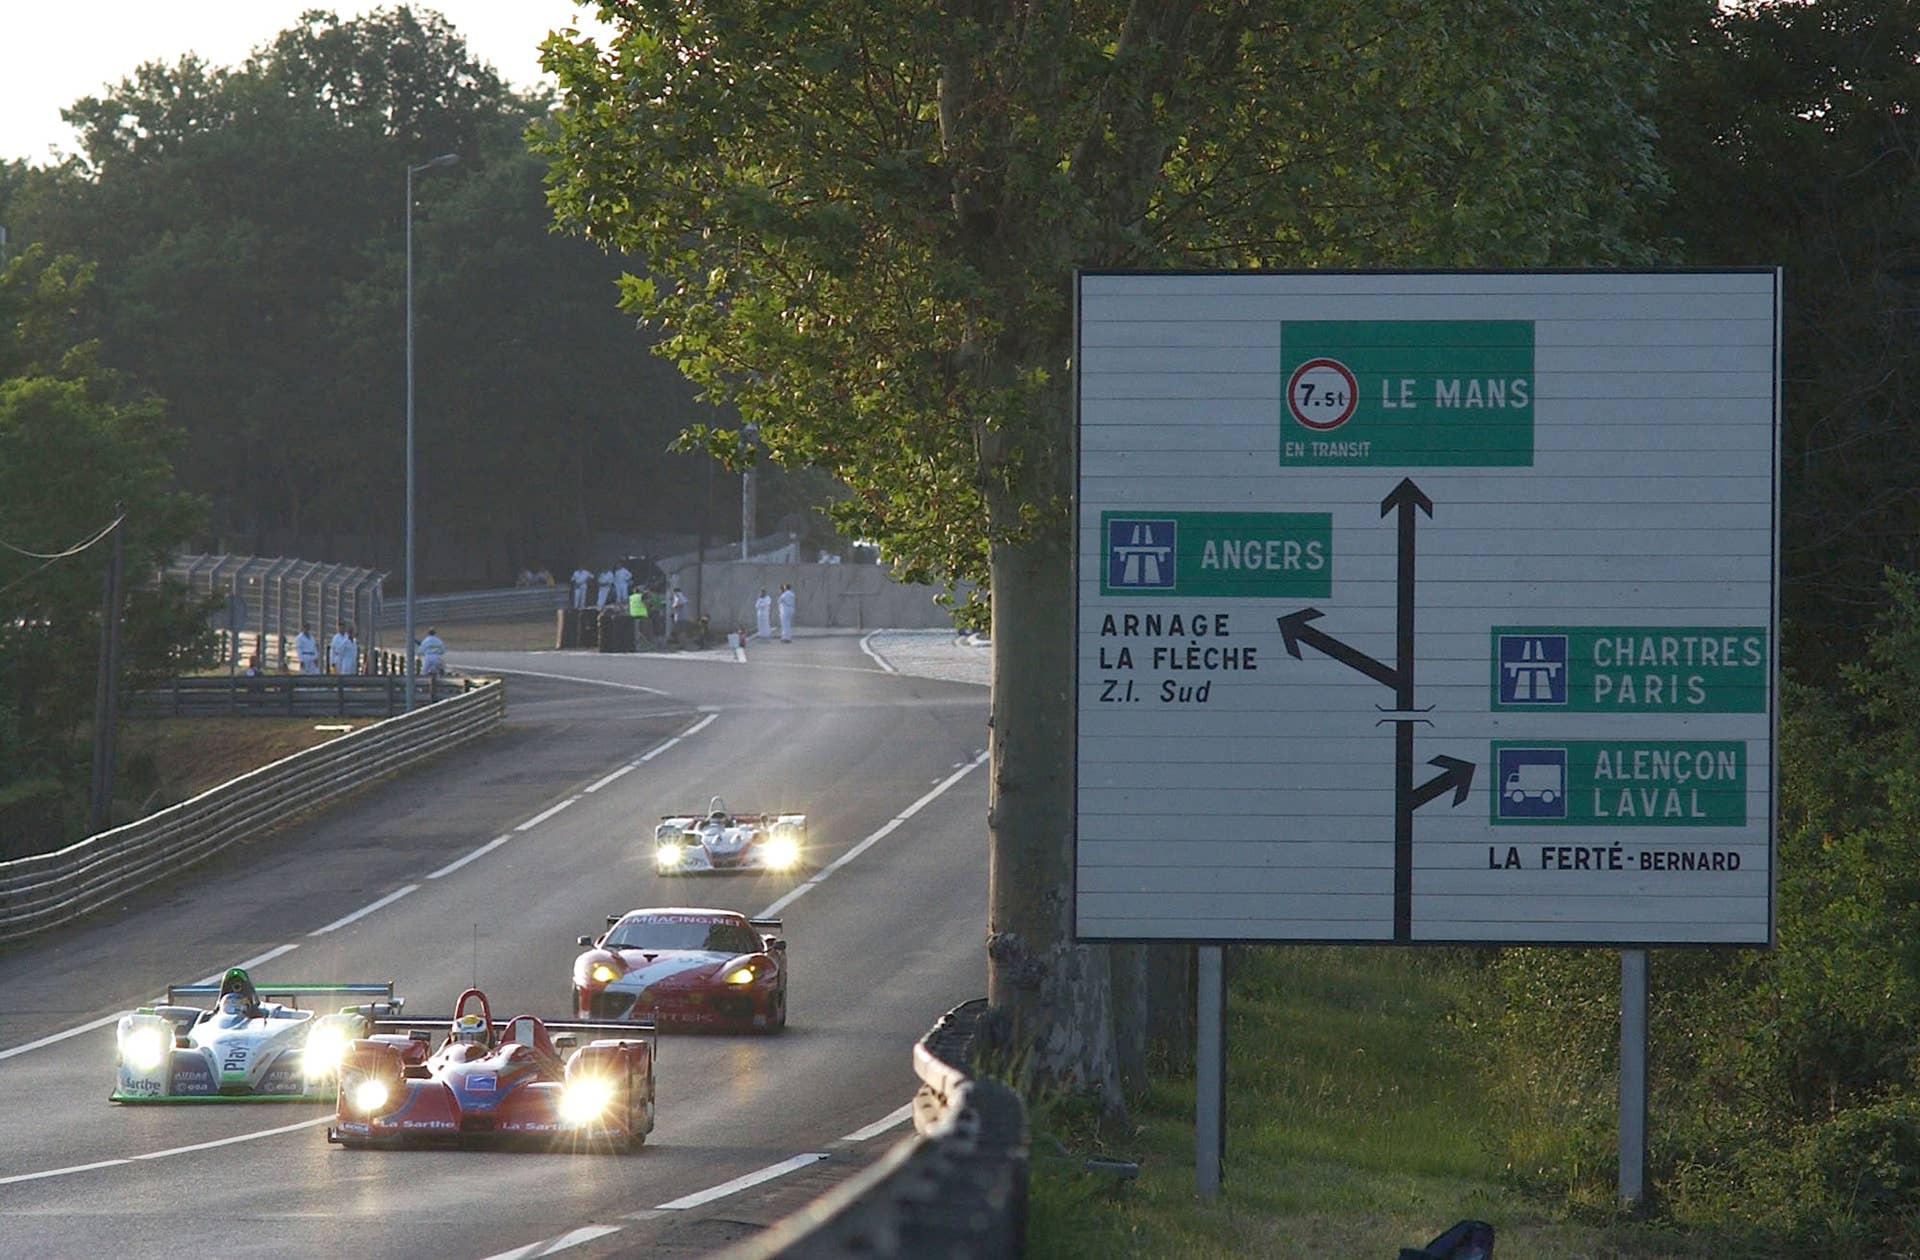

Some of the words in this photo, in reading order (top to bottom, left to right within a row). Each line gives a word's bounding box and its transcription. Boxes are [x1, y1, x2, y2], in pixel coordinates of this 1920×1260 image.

[1382, 379, 1417, 408] LE
[1435, 378, 1529, 408] MANS
[1285, 442, 1304, 457] EN
[1311, 442, 1371, 457] TRANSIT
[1200, 540, 1325, 570] ANGERS
[1100, 614, 1230, 637] ARNAGE
[1100, 647, 1133, 669] LA
[1153, 640, 1258, 670] FLÈCHE
[1594, 637, 1762, 667] CHARTRES
[1100, 679, 1140, 702] Z.I.
[1160, 679, 1212, 703] Sud
[1595, 675, 1706, 705] PARIS
[1594, 750, 1737, 784] ALENÇON
[1594, 788, 1707, 818] LAVAL
[1489, 847, 1522, 870] LA
[403, 1120, 455, 1129] Sarthe
